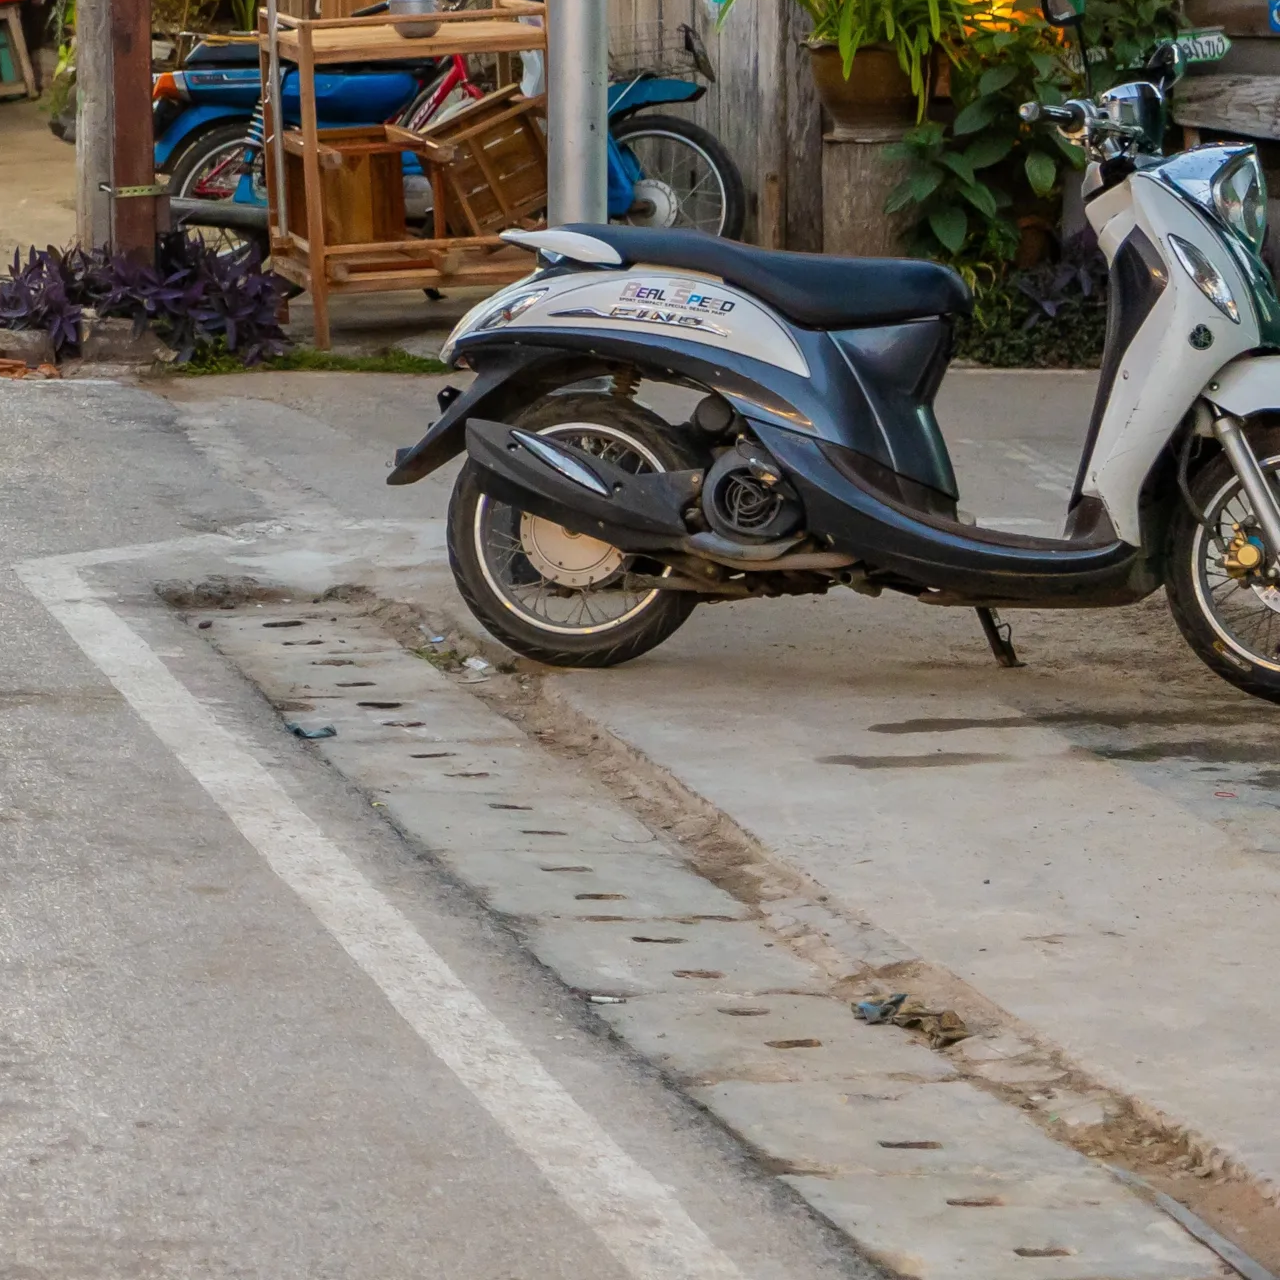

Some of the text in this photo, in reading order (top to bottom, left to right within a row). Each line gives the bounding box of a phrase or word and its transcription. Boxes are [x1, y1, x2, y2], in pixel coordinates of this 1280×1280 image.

[620, 280, 736, 313] REAL SPEED
[638, 299, 663, 307] COMPACT
[665, 303, 687, 311] SPECIAL
[689, 306, 710, 314] DESIGN
